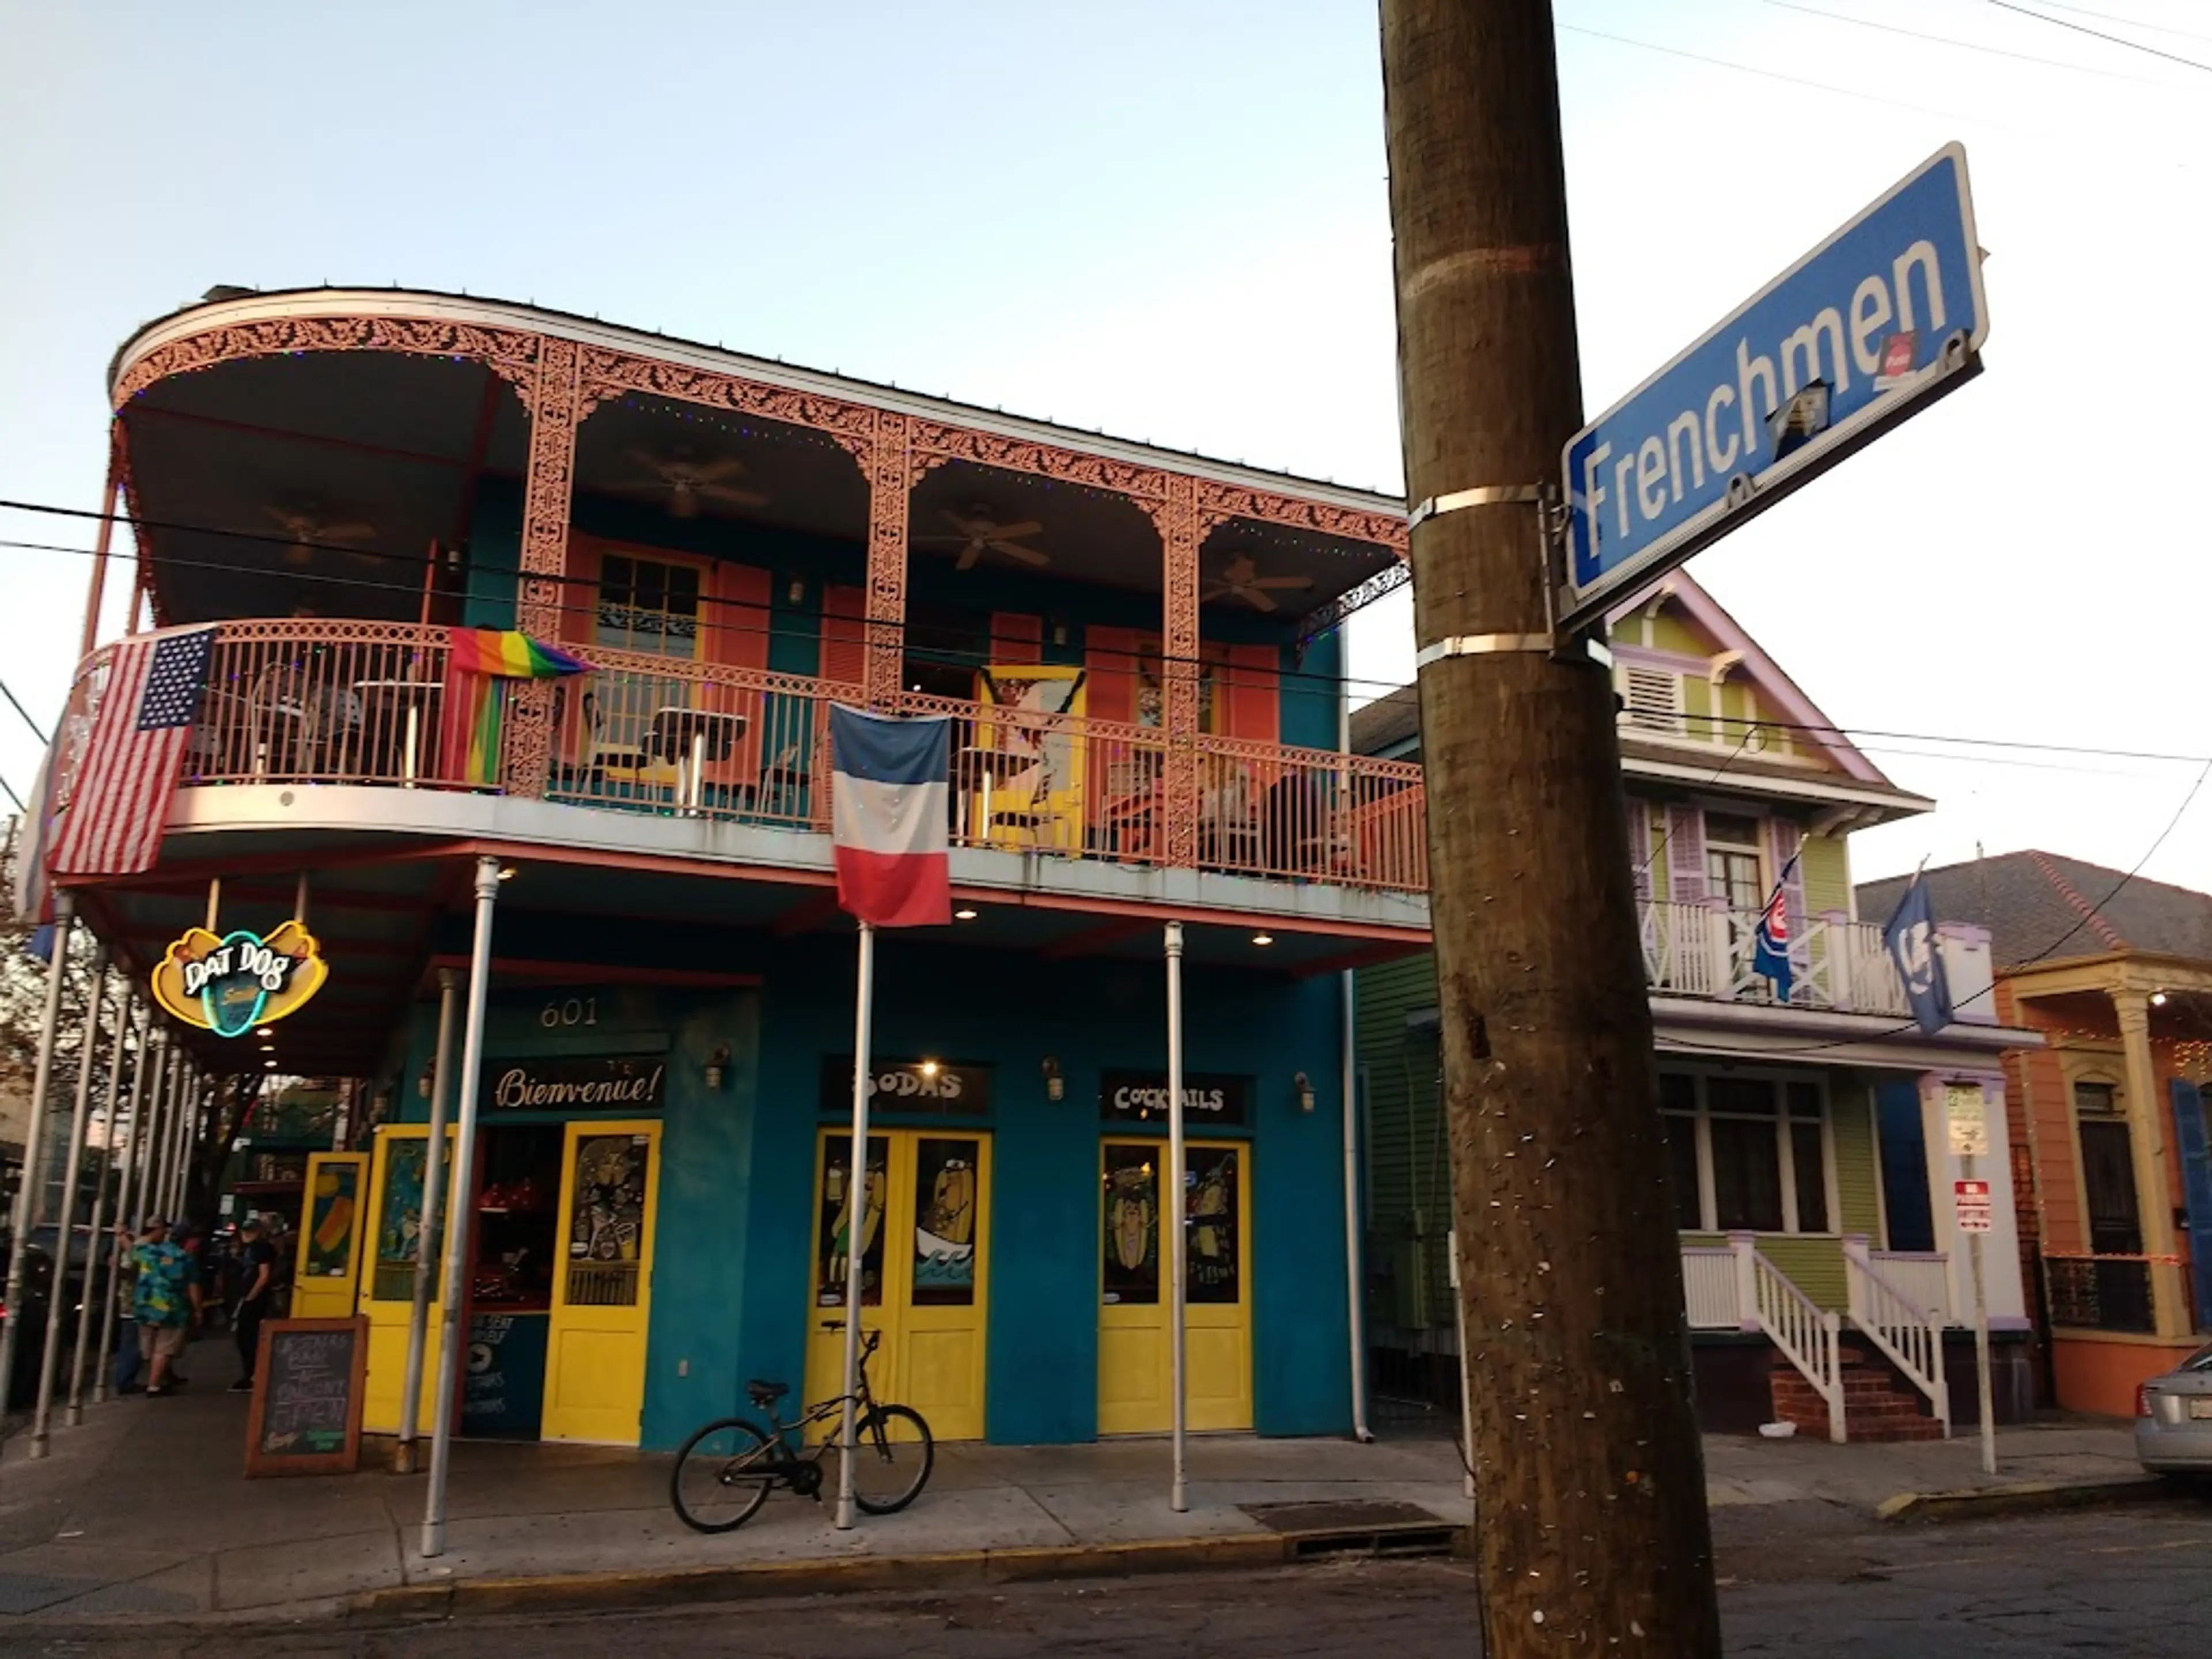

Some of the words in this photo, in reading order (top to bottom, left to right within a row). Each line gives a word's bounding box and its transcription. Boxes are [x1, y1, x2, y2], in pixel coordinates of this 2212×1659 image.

[1583, 240, 1946, 560] Frenchmen
[185, 946, 234, 995] DAT
[539, 997, 598, 1028] 601
[494, 1063, 665, 1108] Bienvenue!
[1113, 1086, 1225, 1112] COCKAILS
